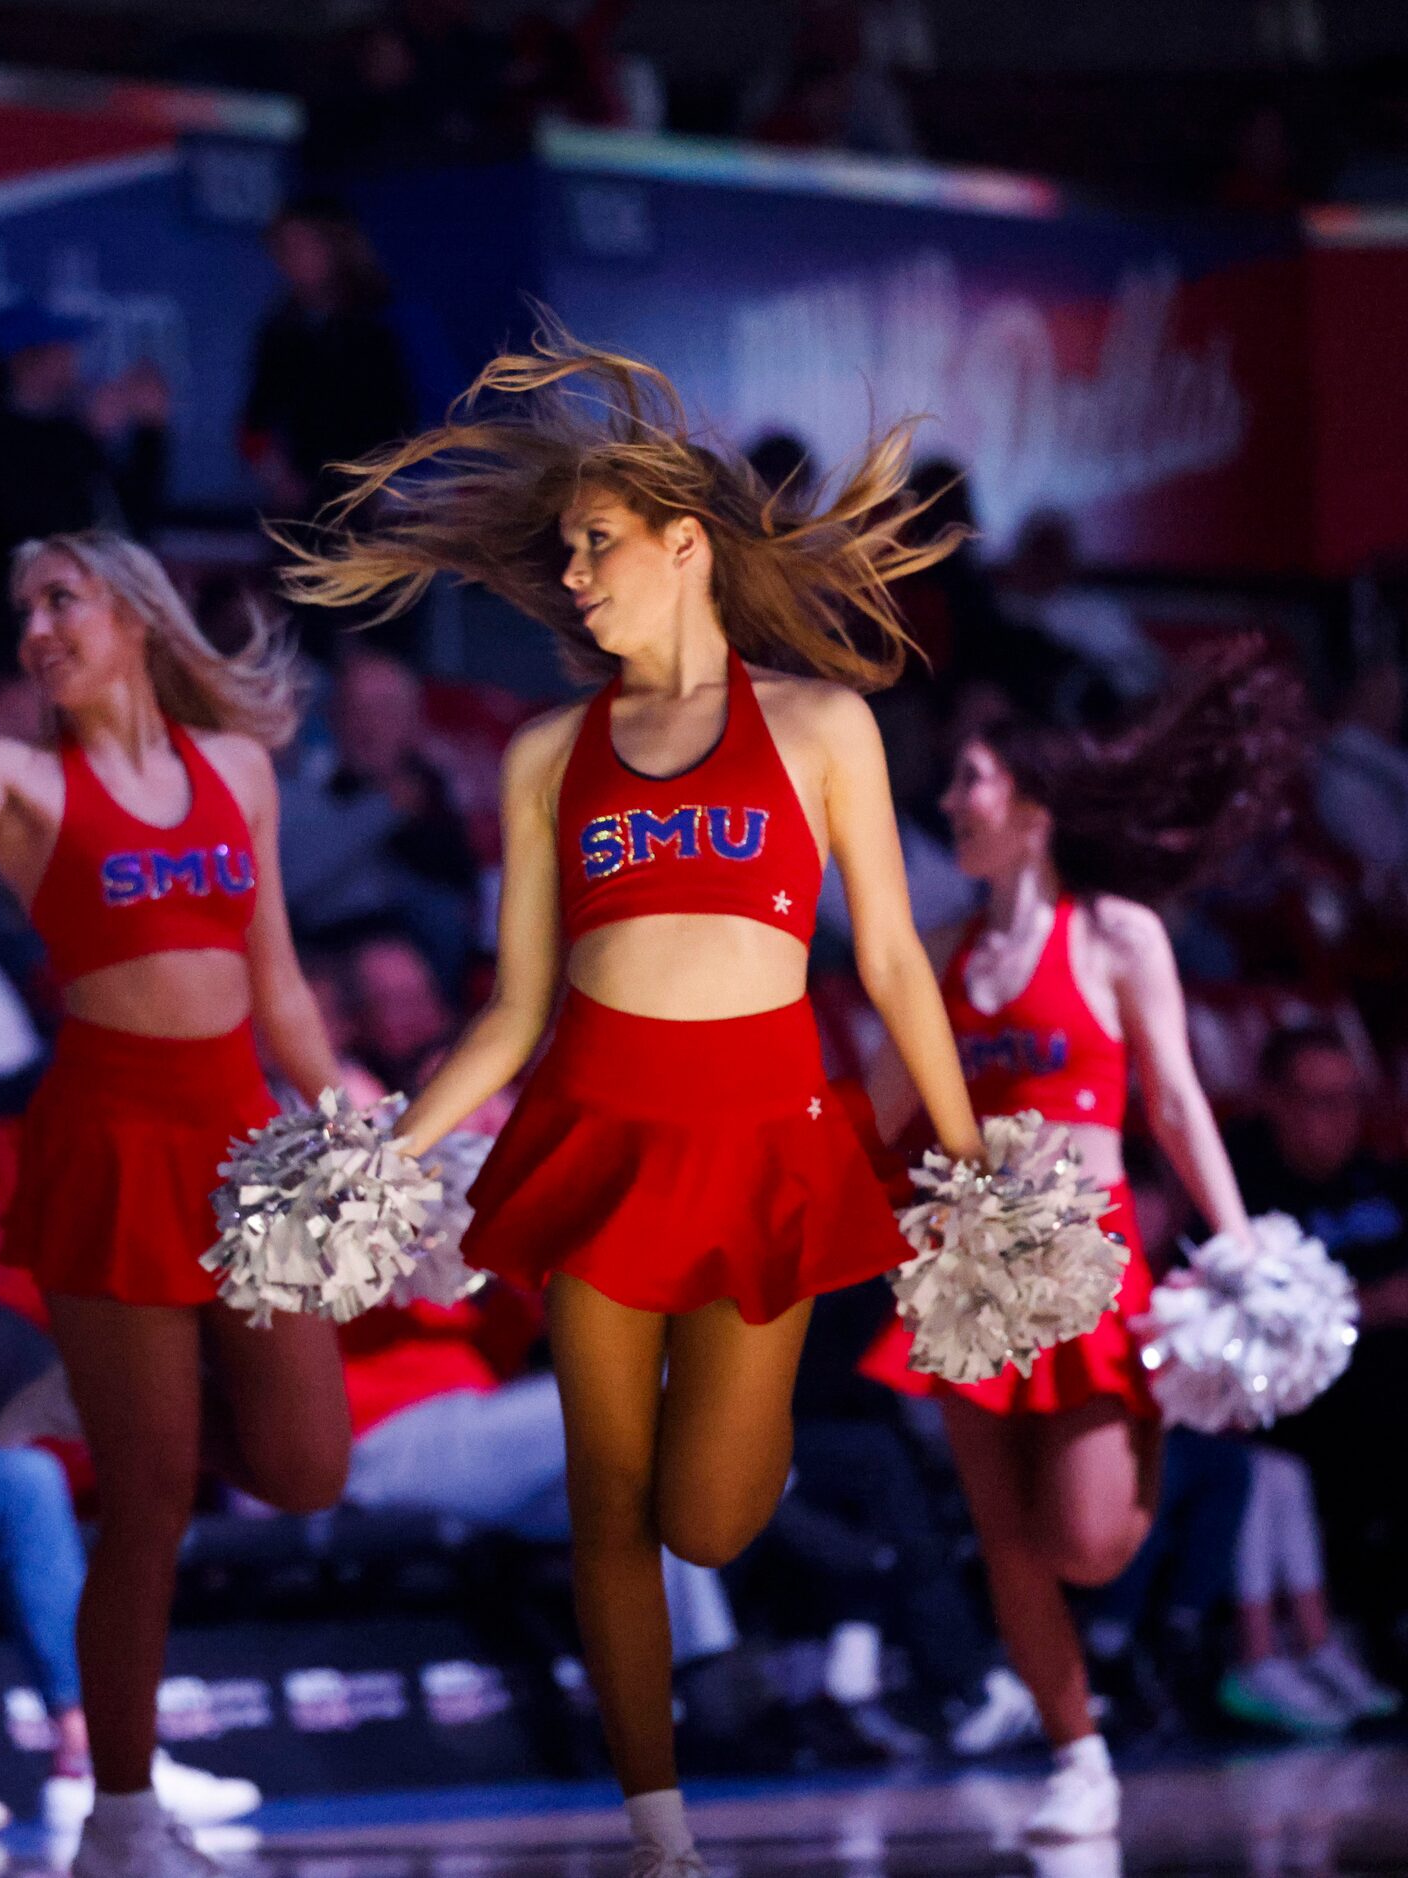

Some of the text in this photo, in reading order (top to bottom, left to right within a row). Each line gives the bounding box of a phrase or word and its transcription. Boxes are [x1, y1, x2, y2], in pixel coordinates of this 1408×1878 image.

[579, 803, 771, 881] SMU
[99, 843, 256, 908] SMU
[958, 1027, 1069, 1082] MU
